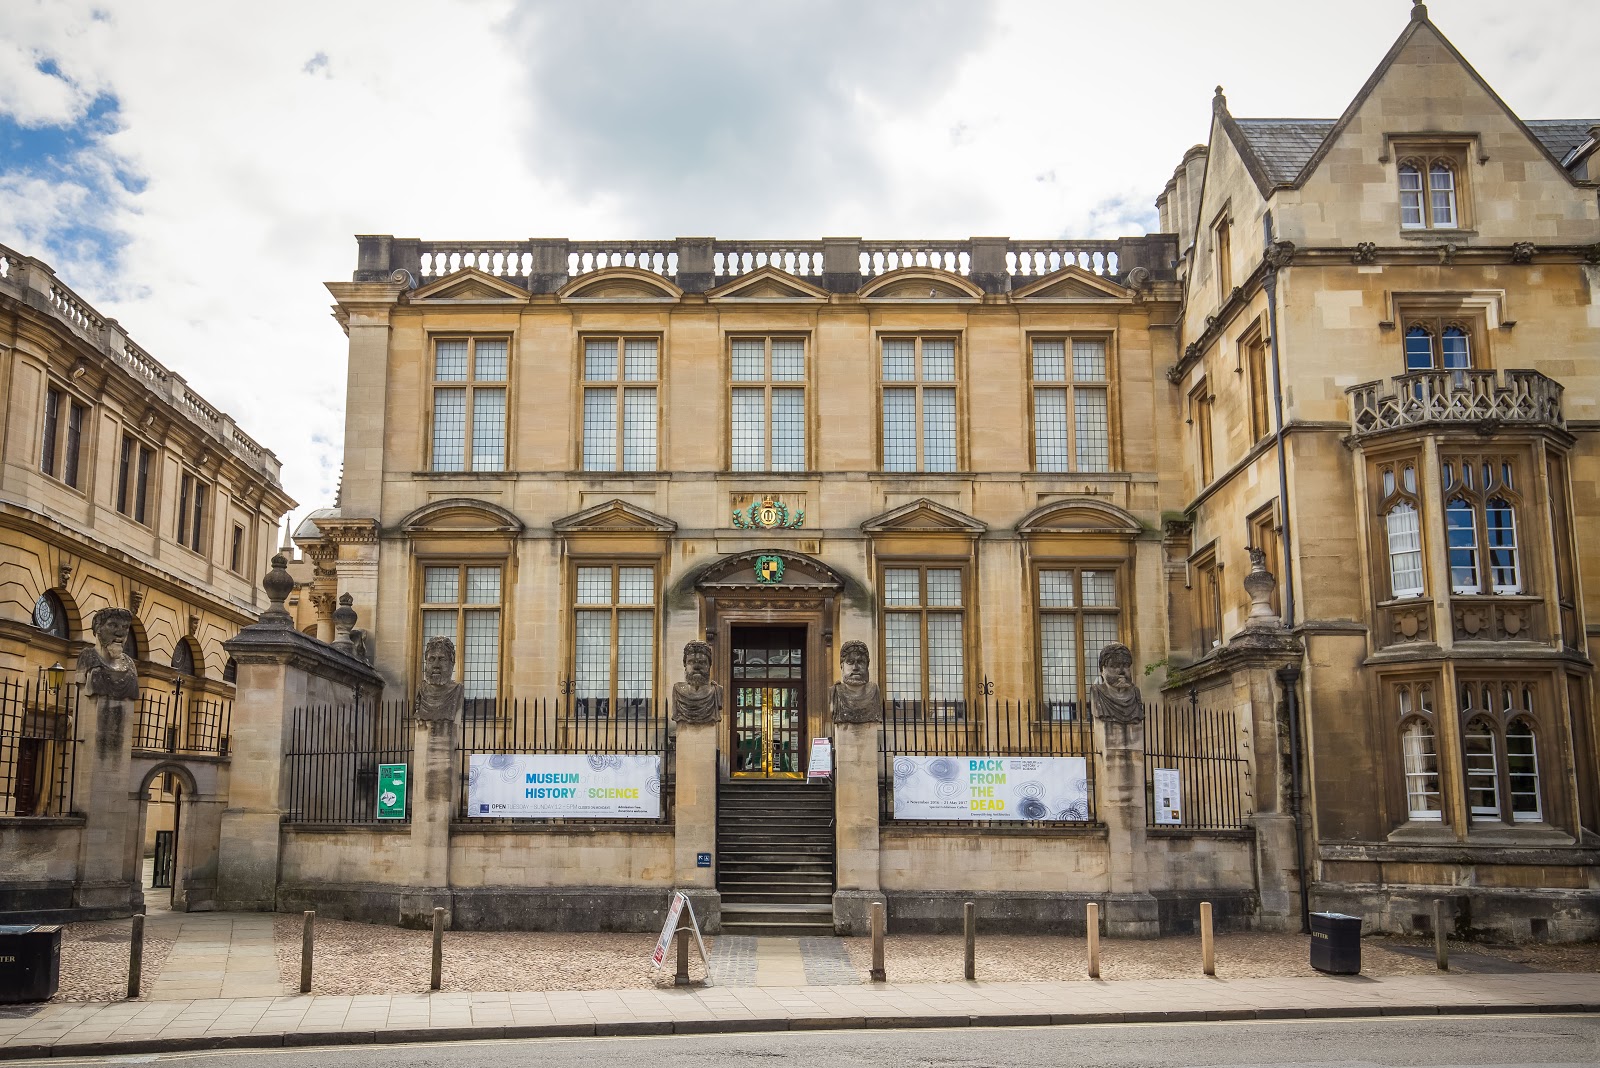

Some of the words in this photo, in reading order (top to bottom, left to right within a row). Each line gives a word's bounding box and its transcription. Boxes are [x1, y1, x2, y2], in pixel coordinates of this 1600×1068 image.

[969, 760, 1004, 771] BACK
[525, 773, 579, 784] MUSEUM
[969, 773, 1007, 784] FROM
[525, 787, 577, 799] HISTORY
[588, 787, 639, 799] SCIENCE
[970, 786, 995, 798] THE
[970, 799, 1005, 811] DEAD
[1312, 931, 1328, 939] LITTER
